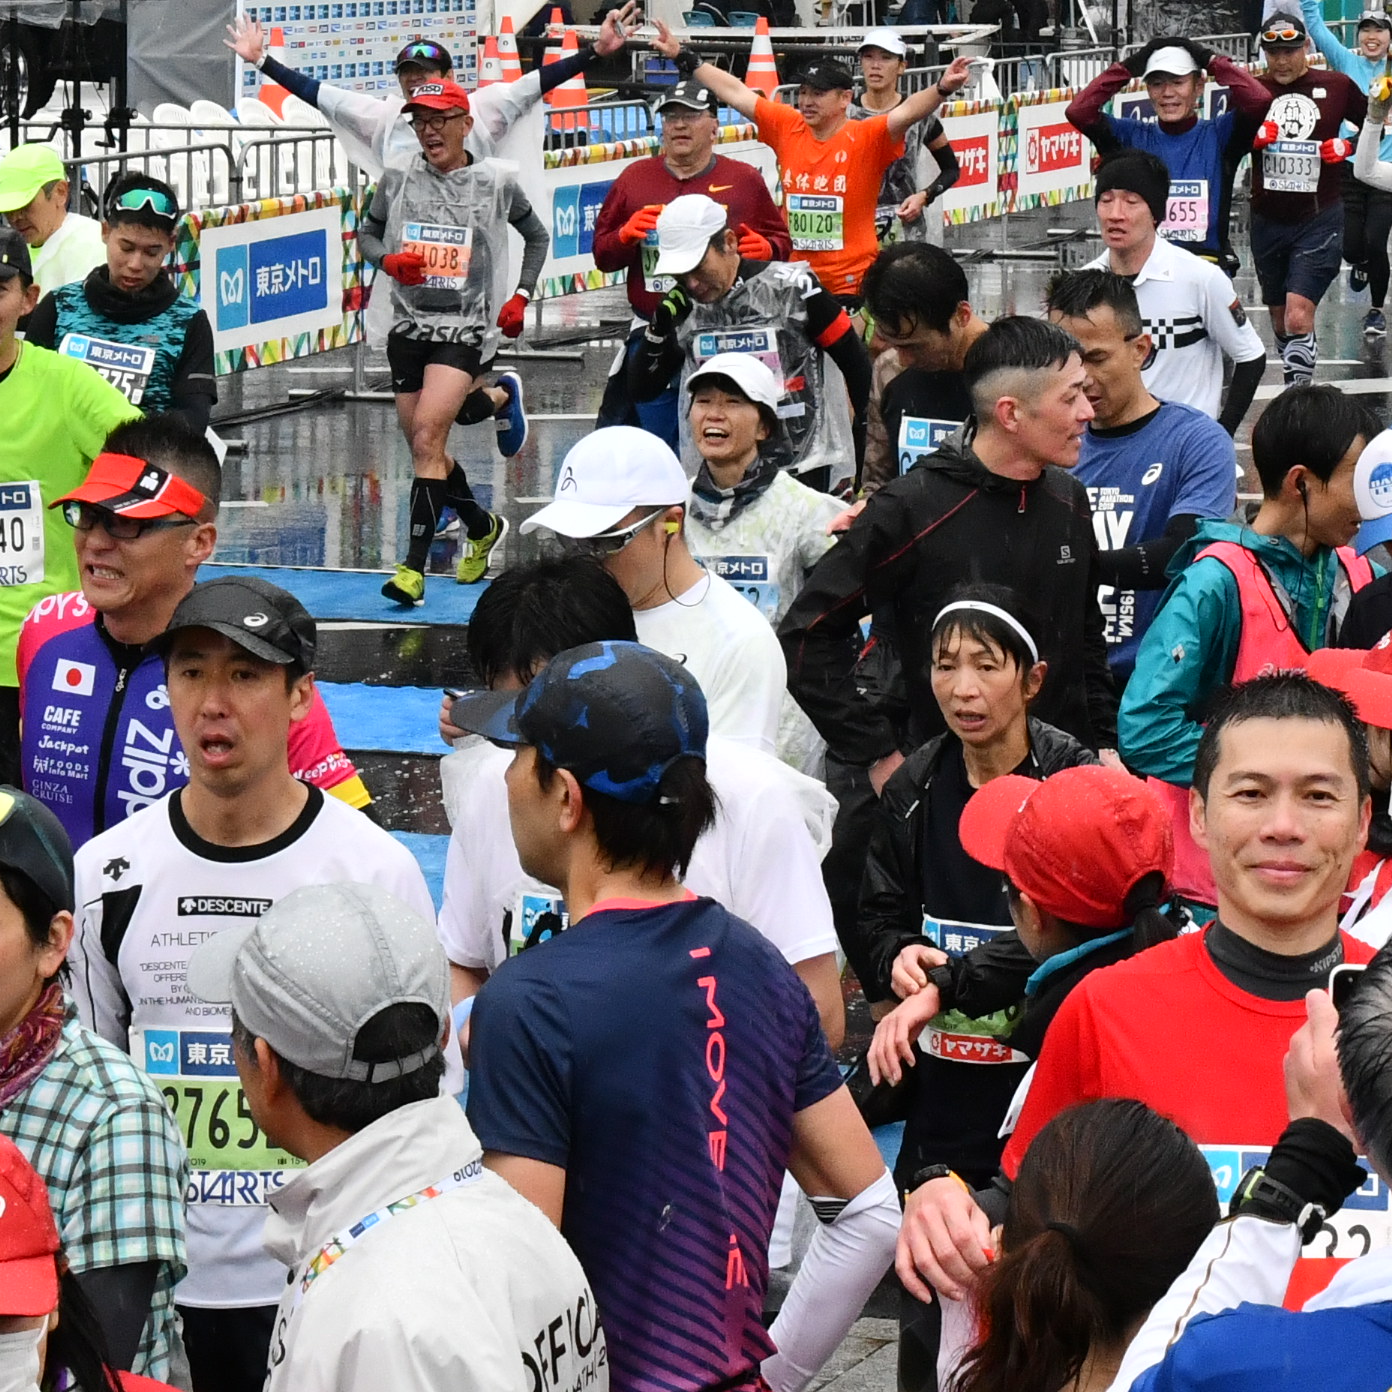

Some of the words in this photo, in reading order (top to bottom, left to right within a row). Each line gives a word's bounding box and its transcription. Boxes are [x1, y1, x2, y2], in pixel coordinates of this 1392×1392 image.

[1040, 131, 1080, 162] ヤマザキ
[1281, 143, 1315, 153] 東京メトロ
[958, 146, 987, 176] マザキ
[1263, 157, 1312, 176] C10333
[801, 199, 835, 208] 東京メトロ
[422, 229, 463, 242] 東京メトロ
[256, 256, 321, 297] 東京メトロ
[91, 346, 142, 365] 東京メトロ
[1099, 488, 1120, 496] TOKYO
[1099, 495, 1134, 503] MARATHON
[716, 562, 763, 575] 京メトロ
[44, 705, 82, 727] CAFE
[41, 723, 78, 734] COMPANY
[38, 735, 89, 756] Jackpot
[49, 760, 90, 772] FOODS
[49, 767, 66, 776] Info
[68, 770, 89, 780] Mart
[32, 779, 68, 794] GINZA
[32, 789, 73, 804] CRUISE
[197, 899, 269, 914] DESCENTE
[153, 972, 187, 982] OFFERS
[147, 997, 165, 1005] THE
[165, 996, 197, 1005] HUMAN
[185, 1007, 201, 1015] AND
[944, 1038, 1007, 1057] ヤマザキ
[697, 975, 728, 1171] MOVE
